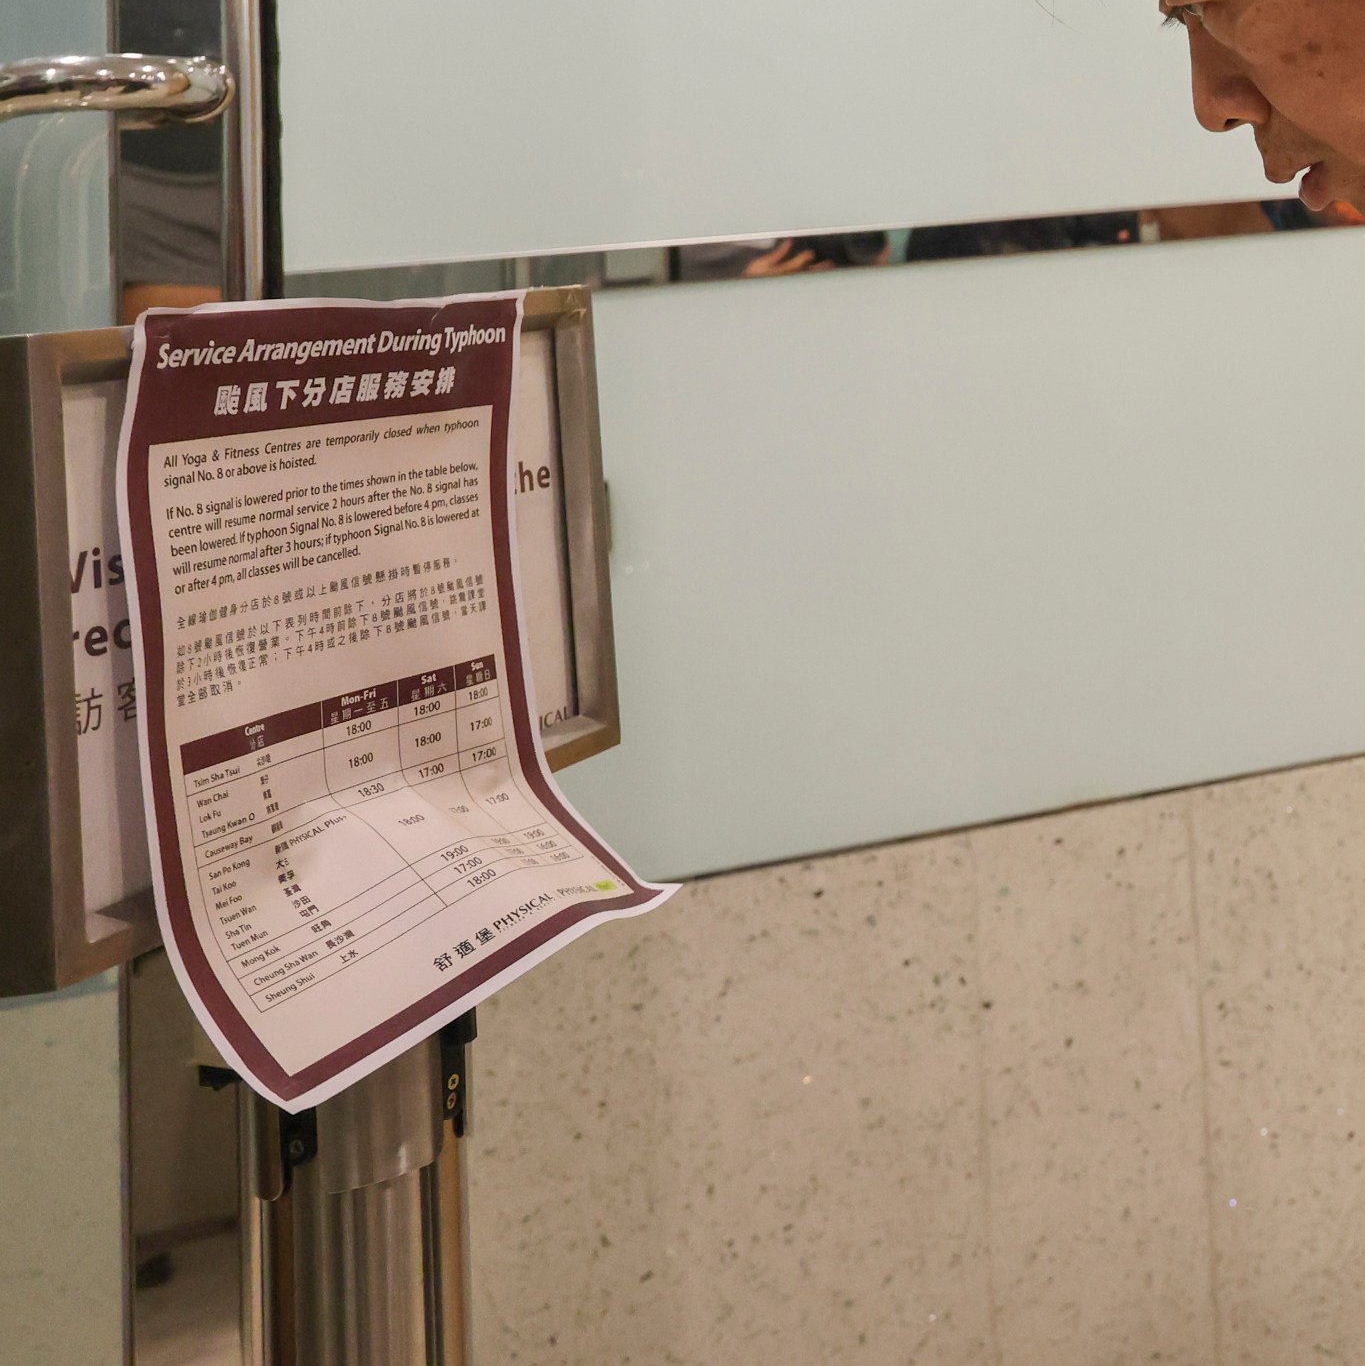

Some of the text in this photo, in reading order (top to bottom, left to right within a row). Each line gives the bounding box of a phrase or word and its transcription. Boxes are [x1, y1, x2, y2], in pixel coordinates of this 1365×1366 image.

[157, 324, 506, 369] Service Arrangement During Typhoon
[164, 419, 479, 468] All Yoga & Fitness Centres are temporarily closed when typhoon
[164, 455, 316, 489] signal No. or above is hoisted.
[167, 462, 478, 520] If No. signal lowered prior to the times shown in the table below,
[168, 477, 478, 538] centre will resume normal service 2 hours after the No. signal has
[171, 493, 478, 556] been lowered. typhoon Signal No. is lowered before 4 pm, classes
[173, 508, 480, 576] will resume normal after 3 hours; typhoon Signal No. lowered at
[175, 545, 361, 595] or after 4 pm, all classes will be cancelled.
[245, 661, 483, 736] Centre Mon-Fri Sat Sun
[331, 698, 389, 724] 星期一至五
[411, 683, 447, 700] 星期六
[193, 687, 488, 788] Tsim Sha Tsui 18:00 18:00 18:00
[200, 717, 492, 823] Lok Fu 18:00 18:00 17:00
[197, 791, 229, 807] Wan Chai
[205, 747, 496, 858] Causeway Bay 18:30 17:00 17:00
[202, 813, 255, 839] Tseung Kwan O
[209, 870, 221, 880] San
[223, 866, 231, 875] Po
[232, 859, 250, 872] Kong
[290, 823, 325, 847] PHYSICAL
[215, 793, 510, 910] Mei Foo 18:00 17:00
[212, 881, 236, 895] Tai Koo
[241, 845, 469, 969] Mong Kok 旺角 19:00
[493, 892, 553, 931] PHYSICAL
[220, 905, 257, 925] Tsuen Wan
[226, 895, 311, 939] Sha Tin 沙田
[231, 904, 319, 951] Tuen Mun 屯門
[254, 966, 285, 986] Cheung
[285, 959, 300, 971] Sha
[301, 950, 318, 963] Wan
[454, 857, 483, 875] 17:00
[265, 868, 497, 1002] Sheung Shui 上水 18:00
[433, 927, 496, 972] 舒適堡
